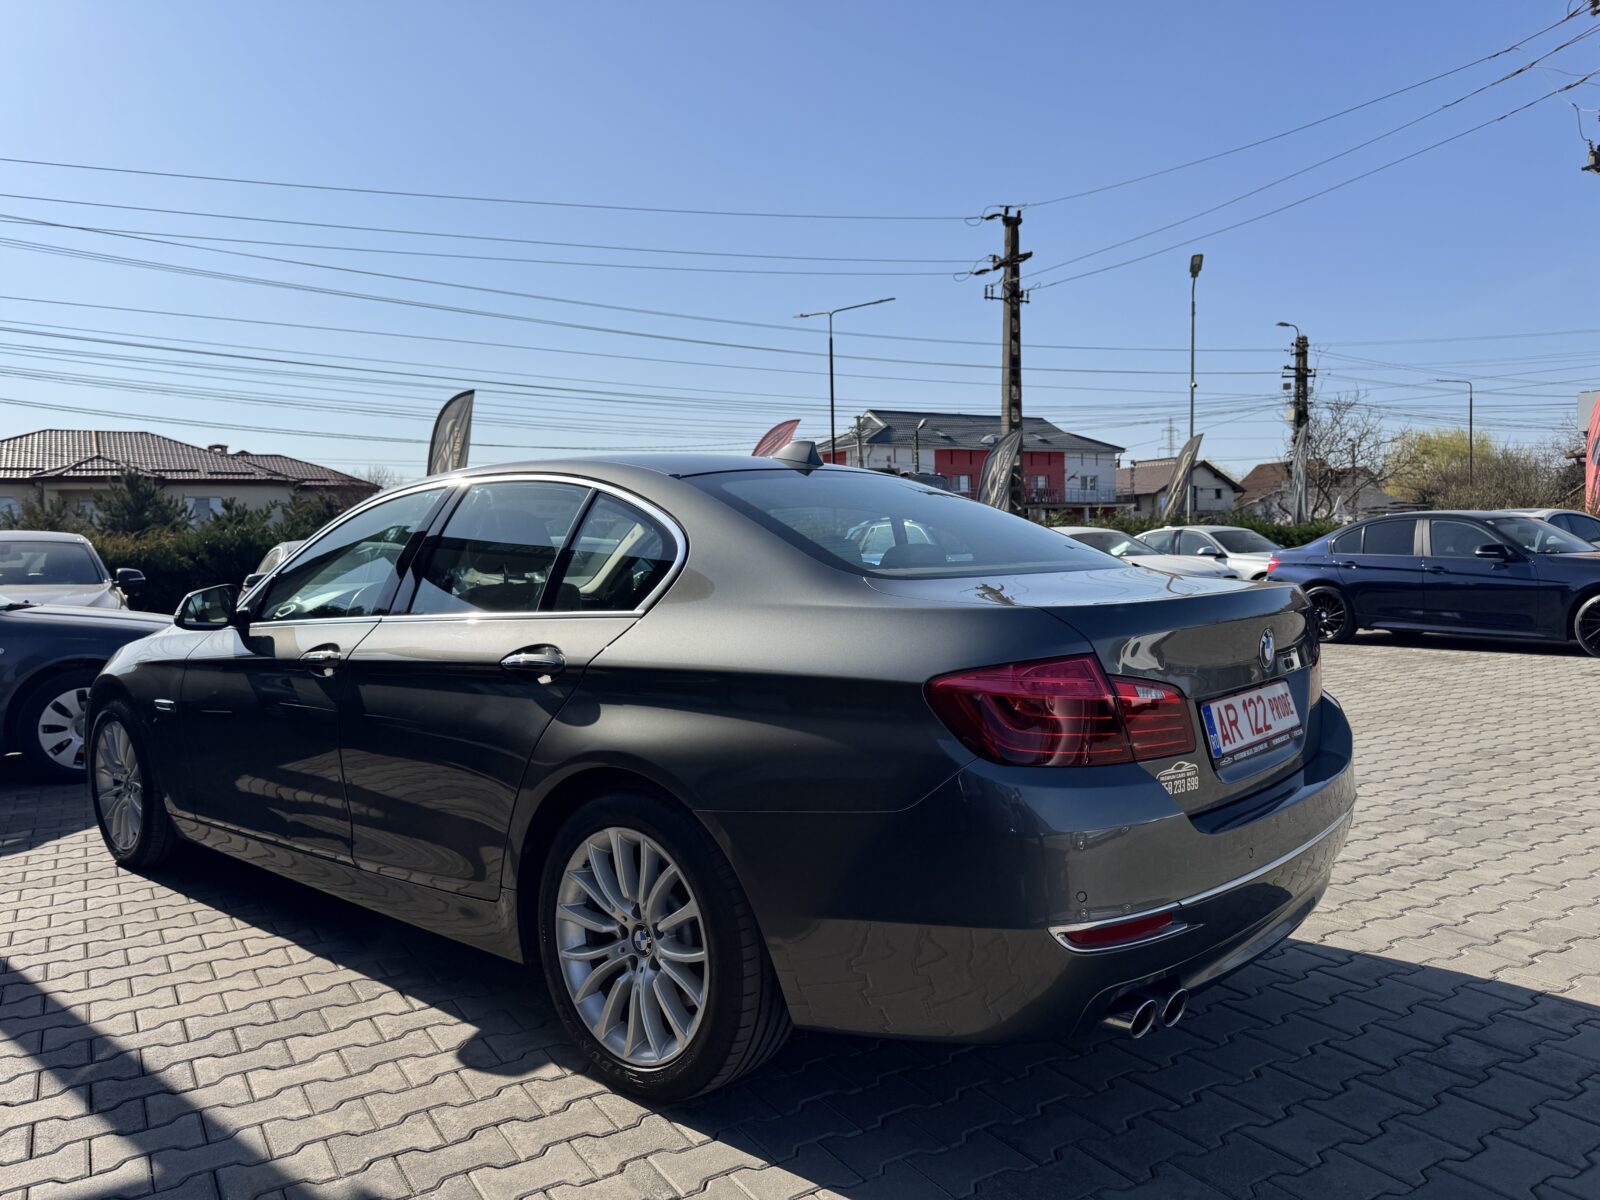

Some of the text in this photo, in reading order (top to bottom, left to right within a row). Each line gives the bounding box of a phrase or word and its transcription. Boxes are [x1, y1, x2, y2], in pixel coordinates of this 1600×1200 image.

[1217, 692, 1294, 747] AR 122 PROBE
[1210, 734, 1221, 750] RO
[1173, 779, 1186, 794] 233
[1186, 776, 1199, 791] 699
